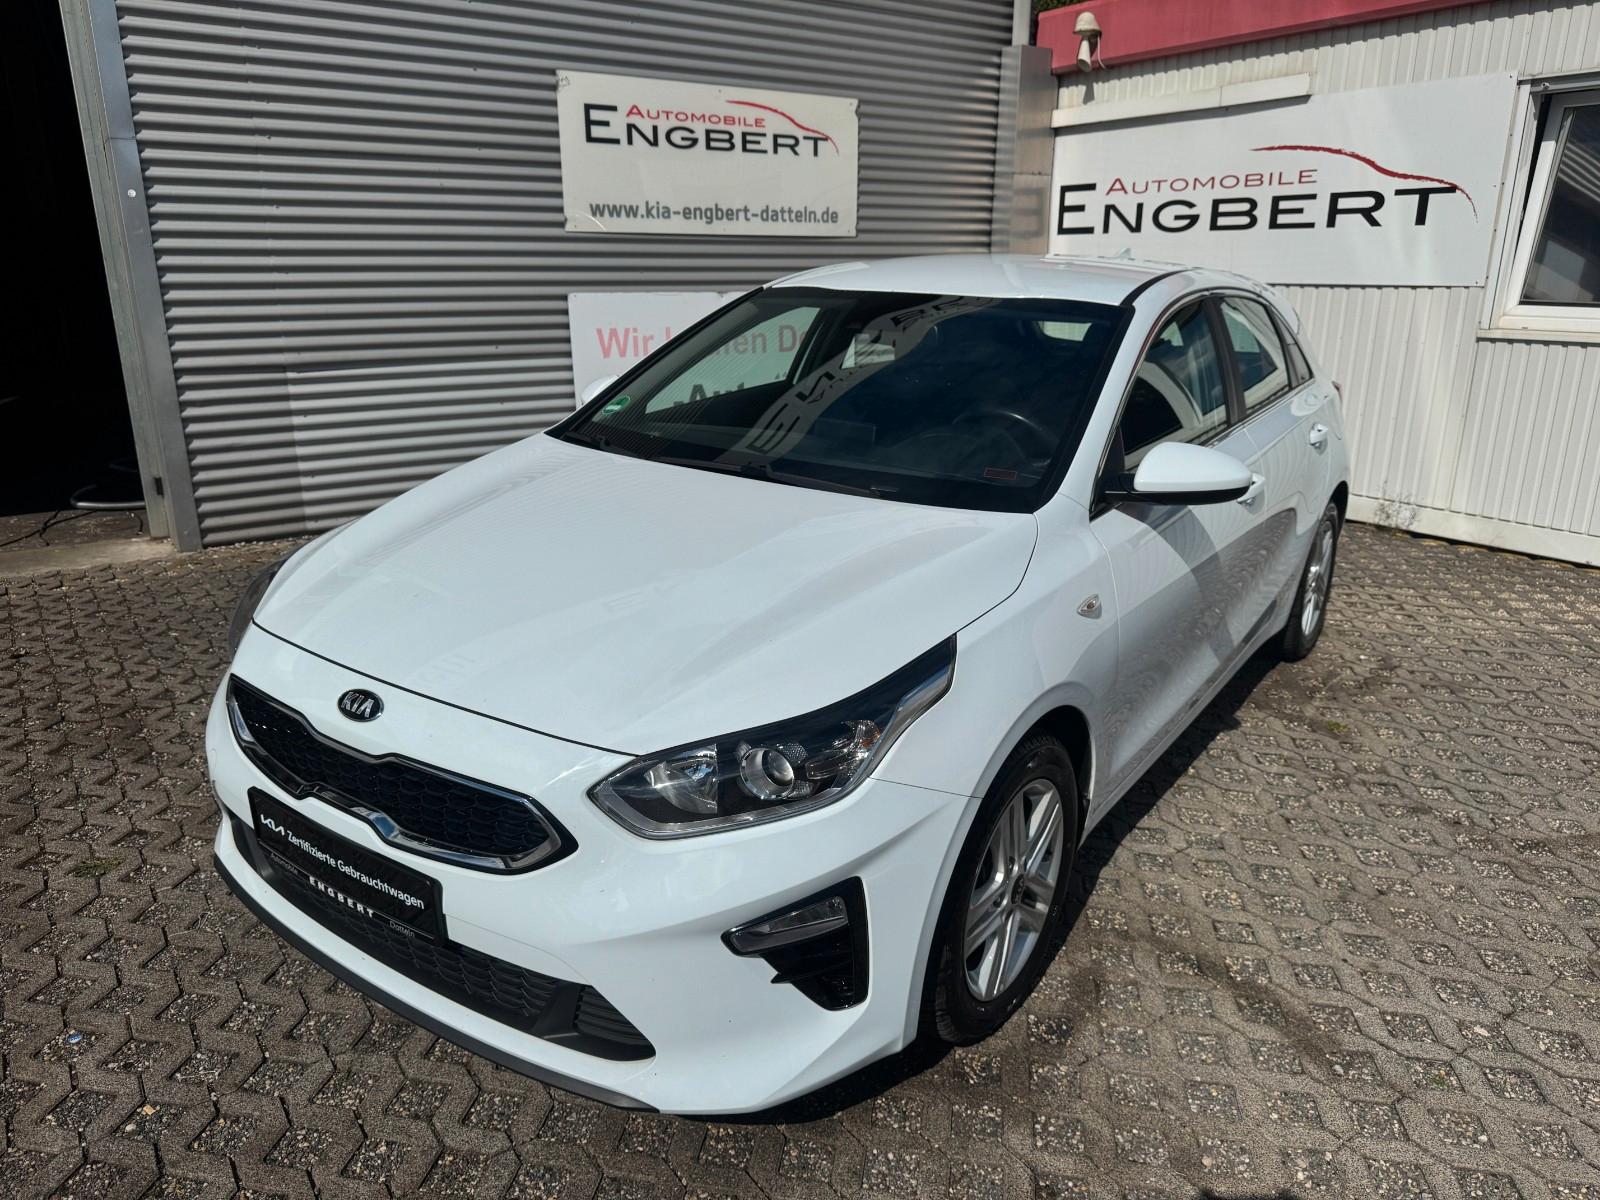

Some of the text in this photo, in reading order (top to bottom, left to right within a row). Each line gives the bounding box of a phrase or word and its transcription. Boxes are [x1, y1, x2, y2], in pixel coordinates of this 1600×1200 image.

[583, 103, 829, 157] ENGBERT
[626, 104, 766, 128] AUTOMOBILE
[1105, 169, 1319, 196] AUTOMOBILE
[589, 201, 839, 225] www.kia-engbert-datteln.de
[1057, 183, 1458, 235] ENGBERT
[595, 327, 655, 359] Wir
[340, 691, 375, 718] KIA
[286, 830, 336, 867] Zertifizierte
[337, 860, 425, 910] Gebrauchtwagen
[309, 876, 374, 918] ENGBERT
